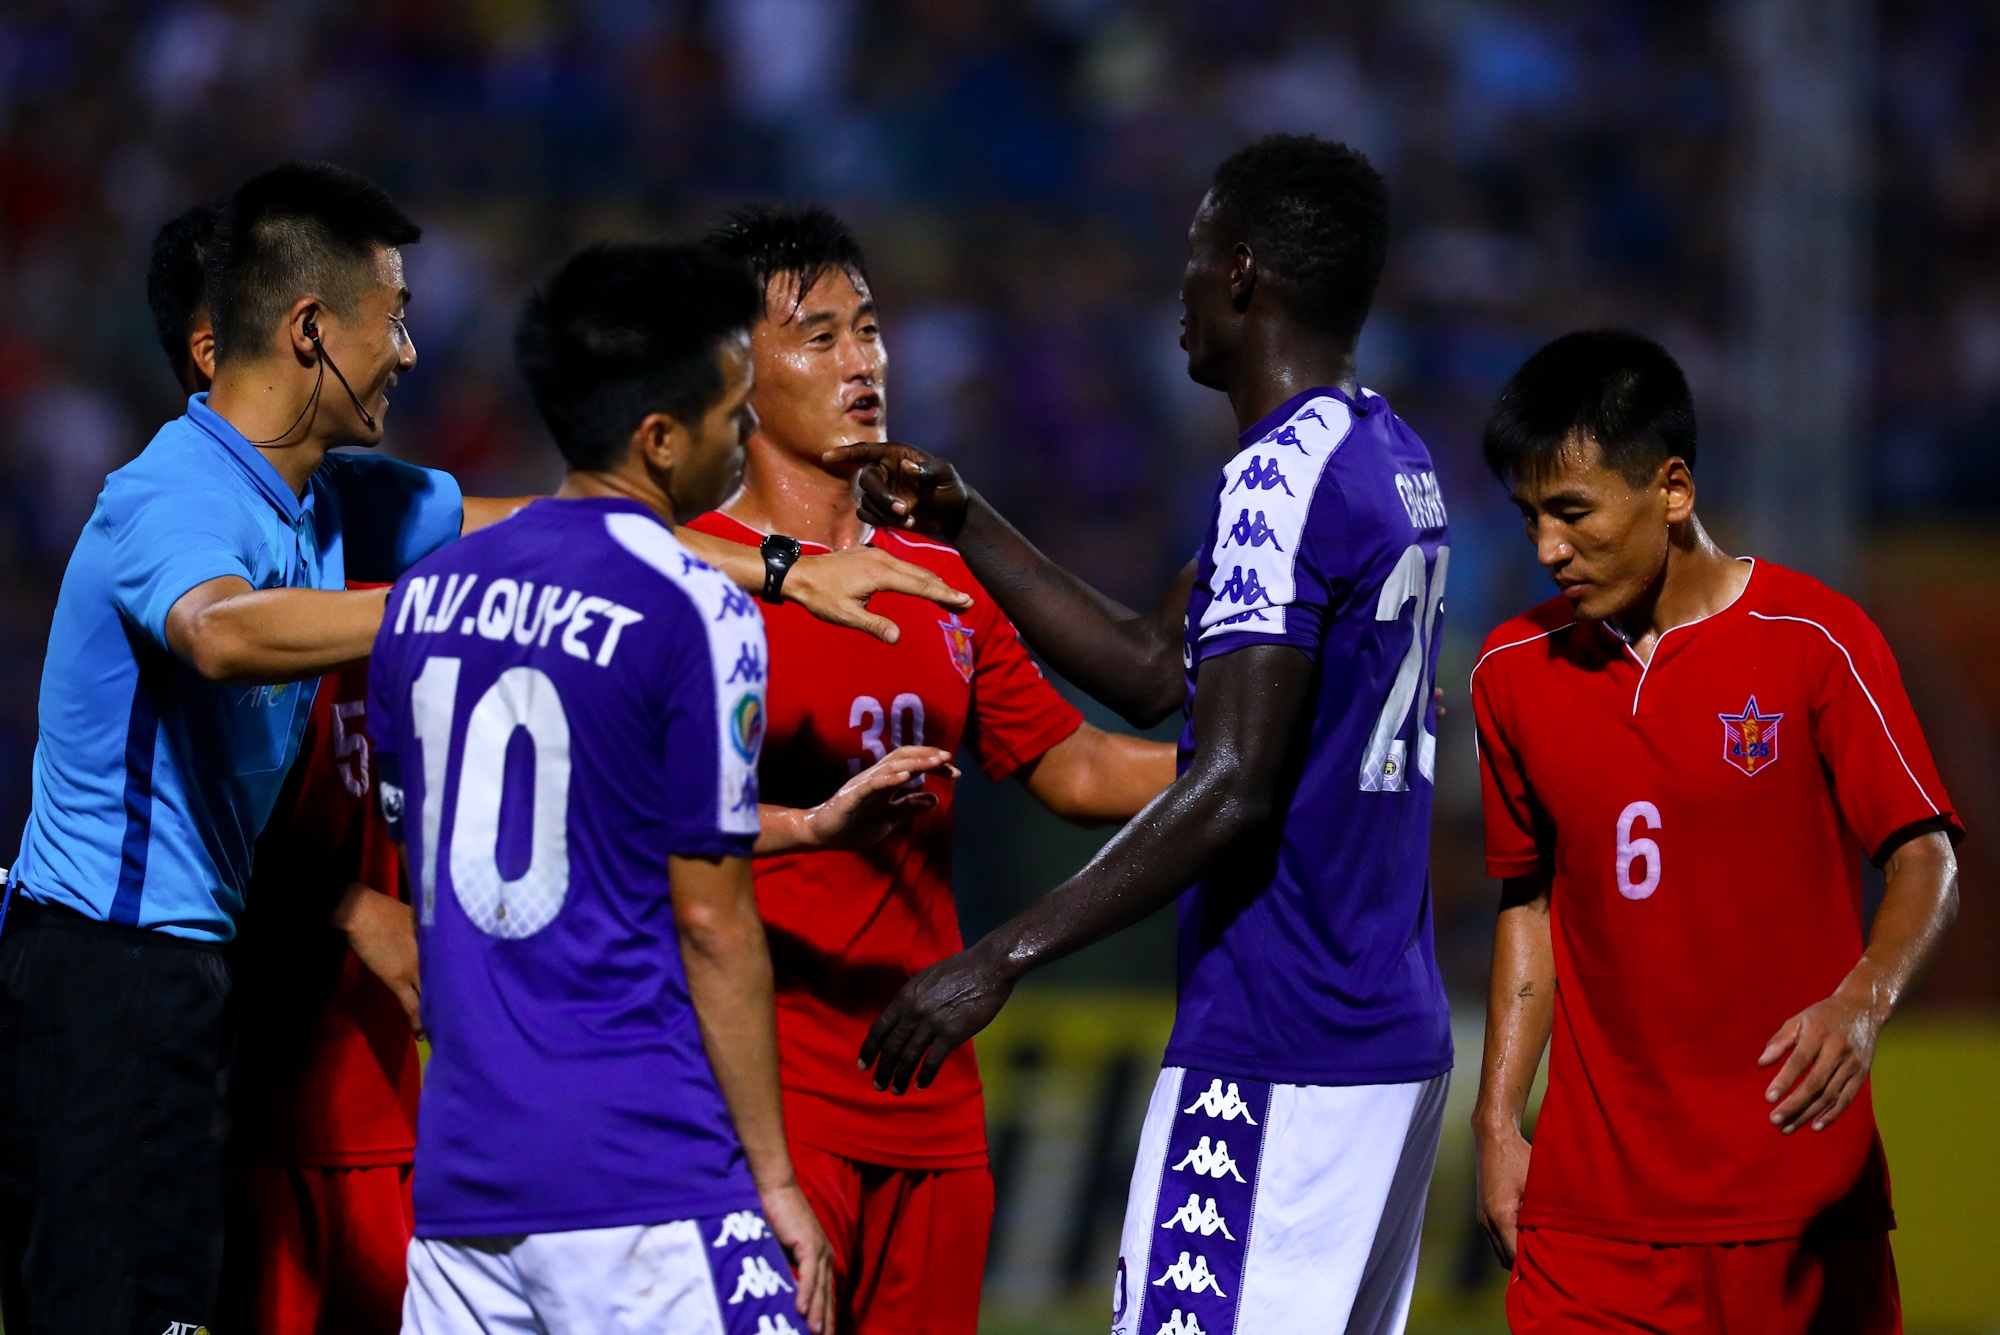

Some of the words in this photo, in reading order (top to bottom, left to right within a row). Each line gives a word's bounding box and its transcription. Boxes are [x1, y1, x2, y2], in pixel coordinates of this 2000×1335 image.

[395, 574, 644, 667] N.V.QUYET
[331, 700, 369, 797] 5
[848, 693, 925, 788] 30
[411, 656, 571, 939] 10
[1616, 801, 1662, 900] 6
